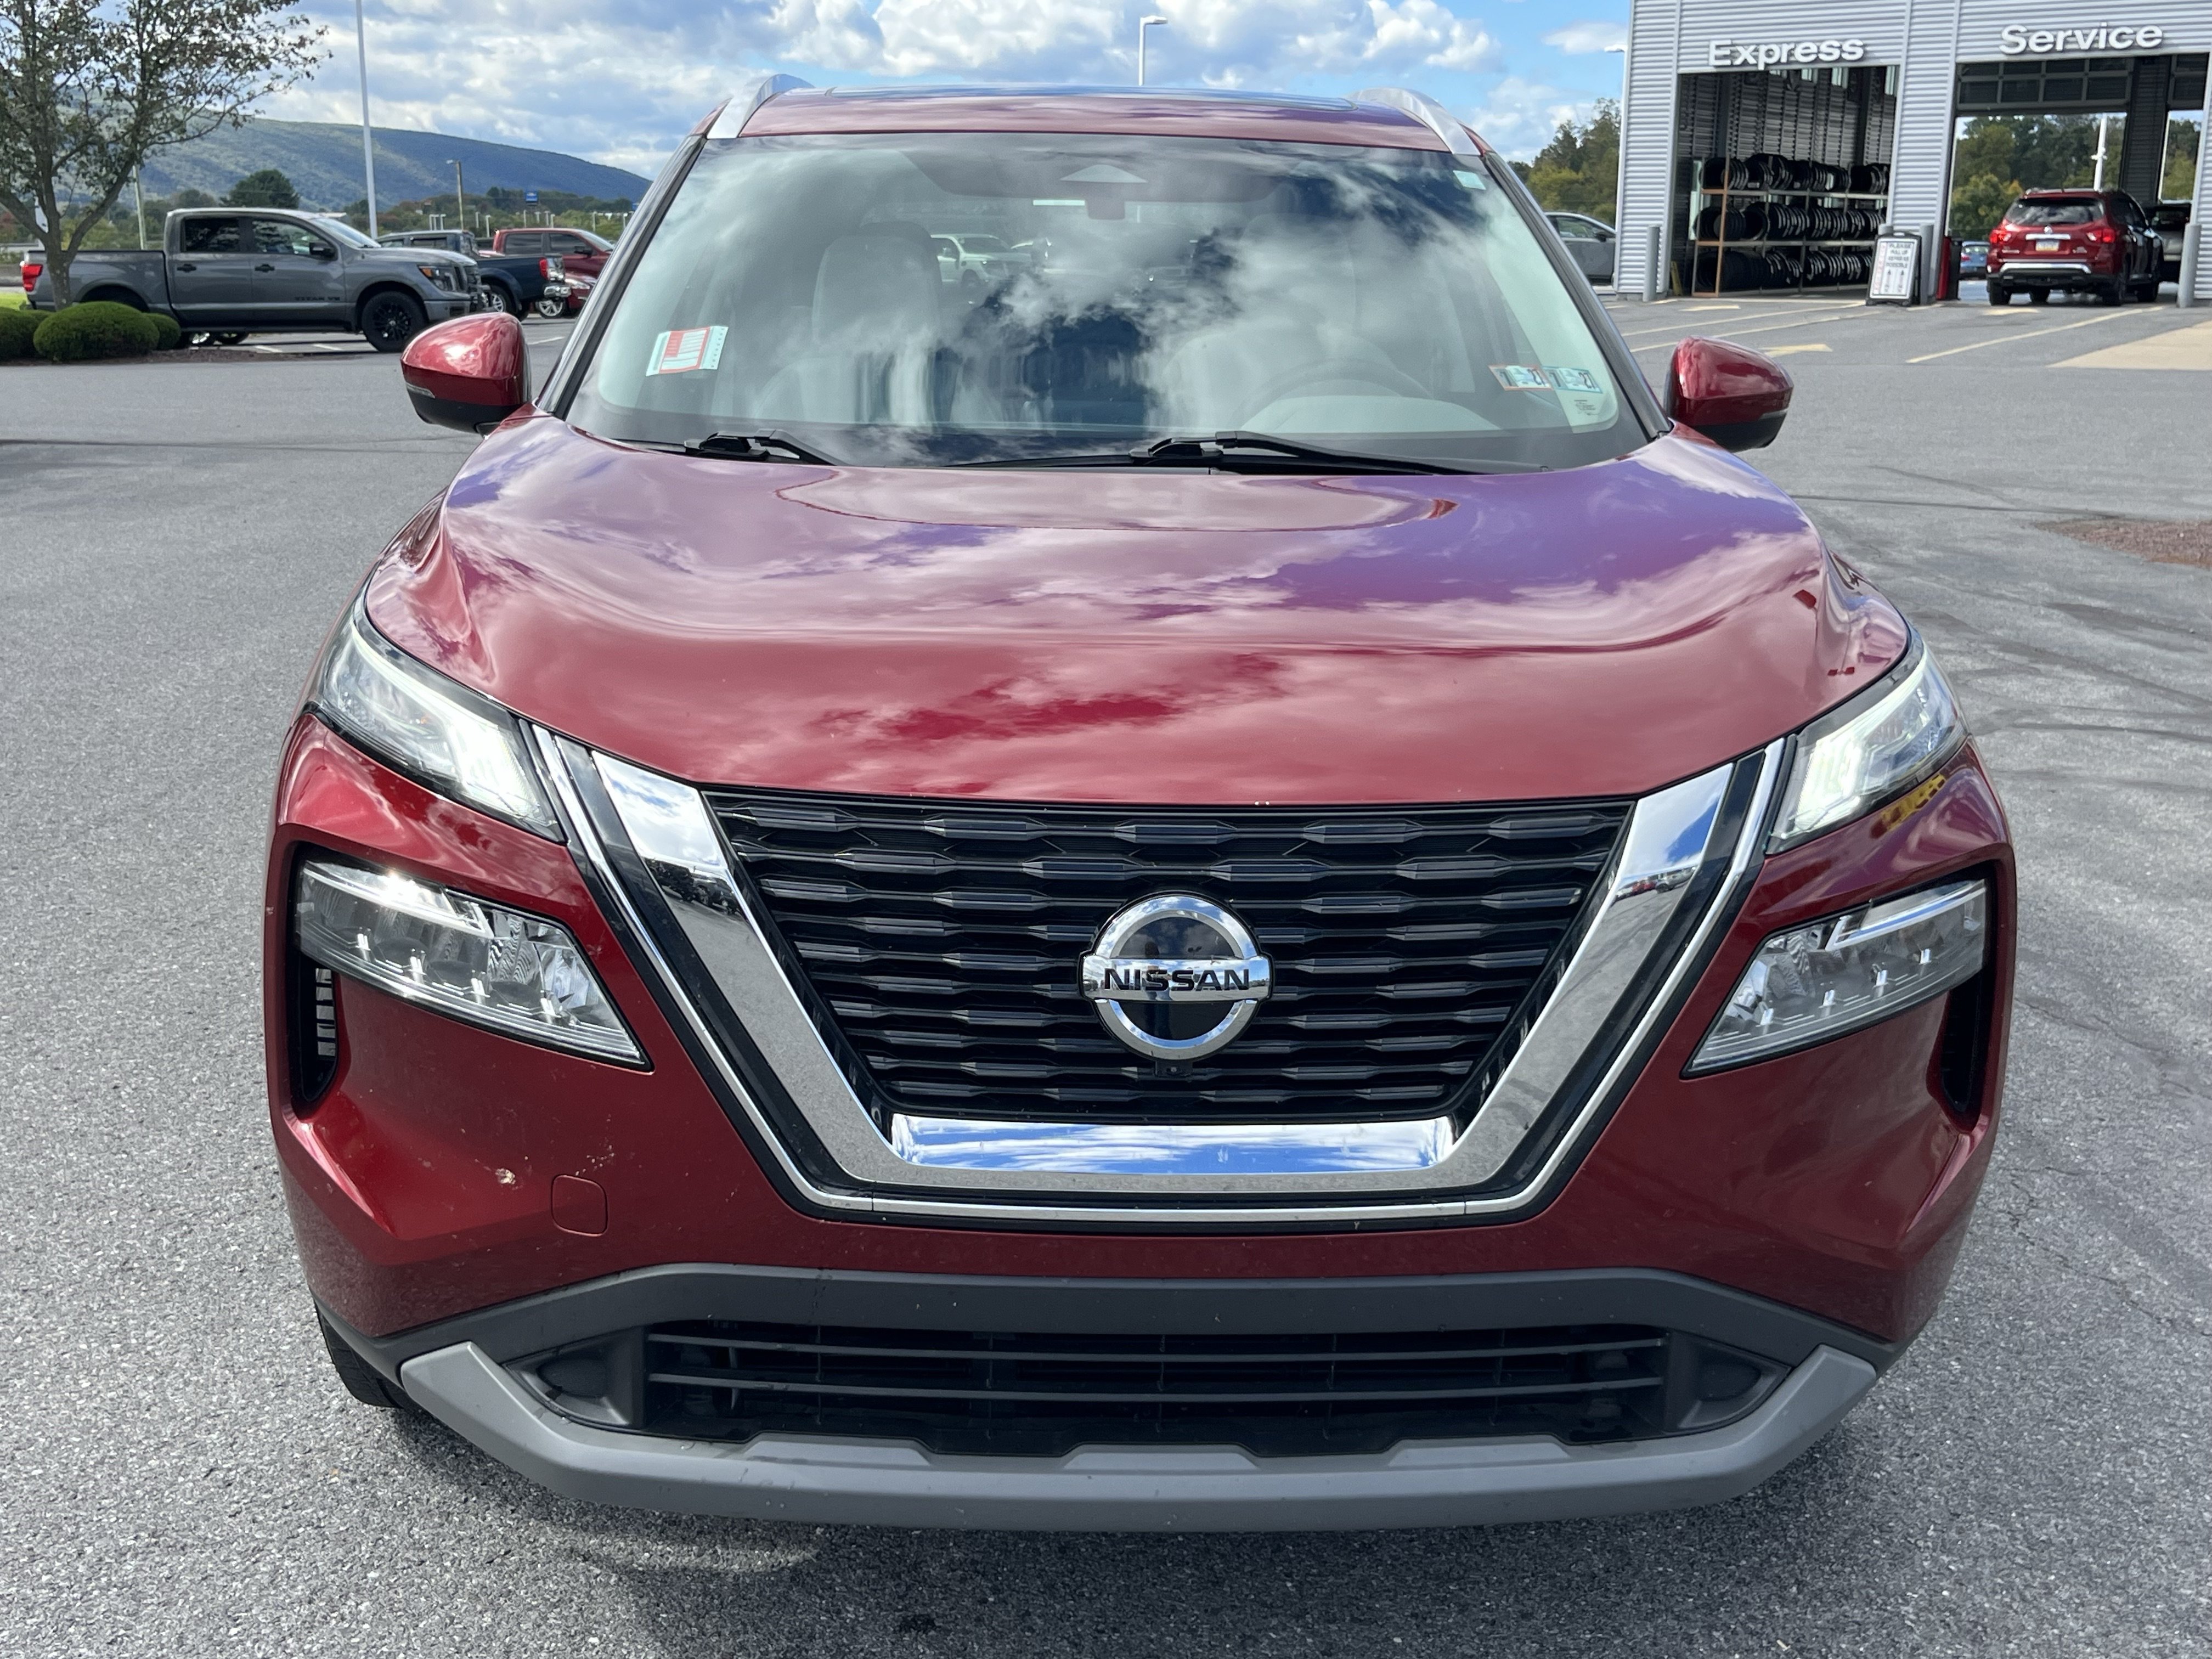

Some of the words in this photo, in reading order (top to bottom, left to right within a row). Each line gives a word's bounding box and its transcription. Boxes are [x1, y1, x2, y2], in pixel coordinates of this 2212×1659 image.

[1708, 38, 1865, 70] Express
[1999, 21, 2164, 54] Service
[1104, 968, 1250, 992] NISSAN
